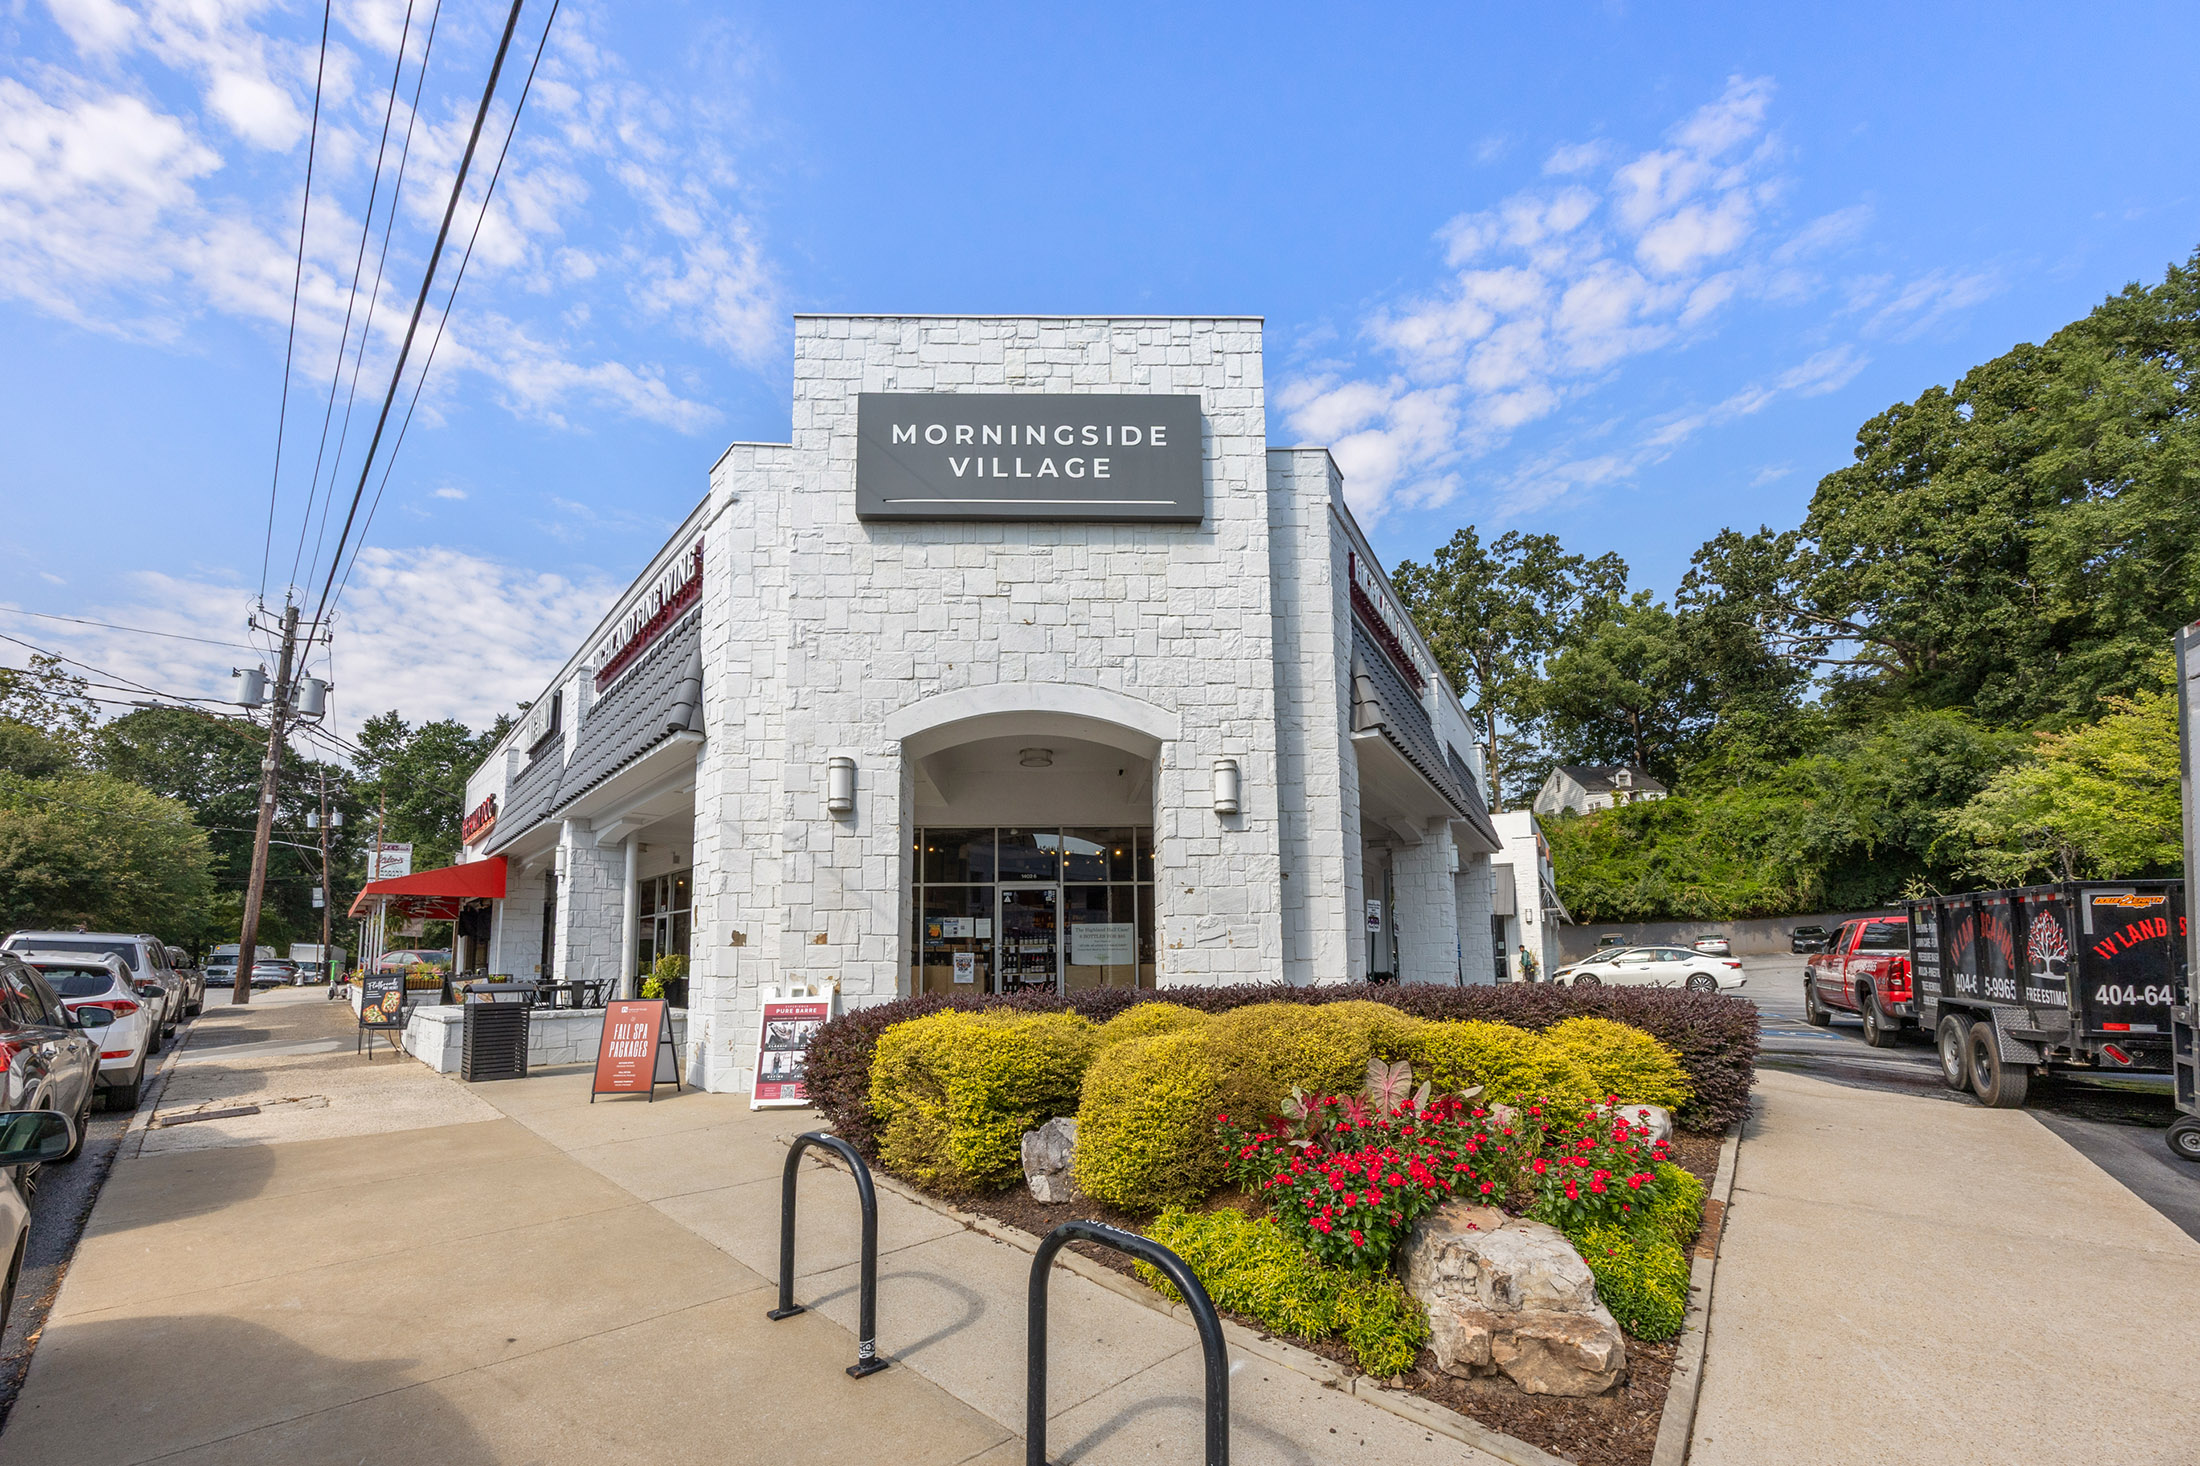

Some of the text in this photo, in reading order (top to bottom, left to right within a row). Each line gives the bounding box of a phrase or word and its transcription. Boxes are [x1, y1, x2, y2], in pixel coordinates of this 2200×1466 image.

[892, 424, 1168, 447] MORNINGSIDE
[948, 456, 1111, 479] VILLAGE
[592, 544, 698, 679] HIGHLAND FINE WINE
[2026, 987, 2068, 1007] FREE ESTIMA
[613, 1023, 649, 1040] FALL SPA
[608, 1040, 649, 1058] PACKAGES
